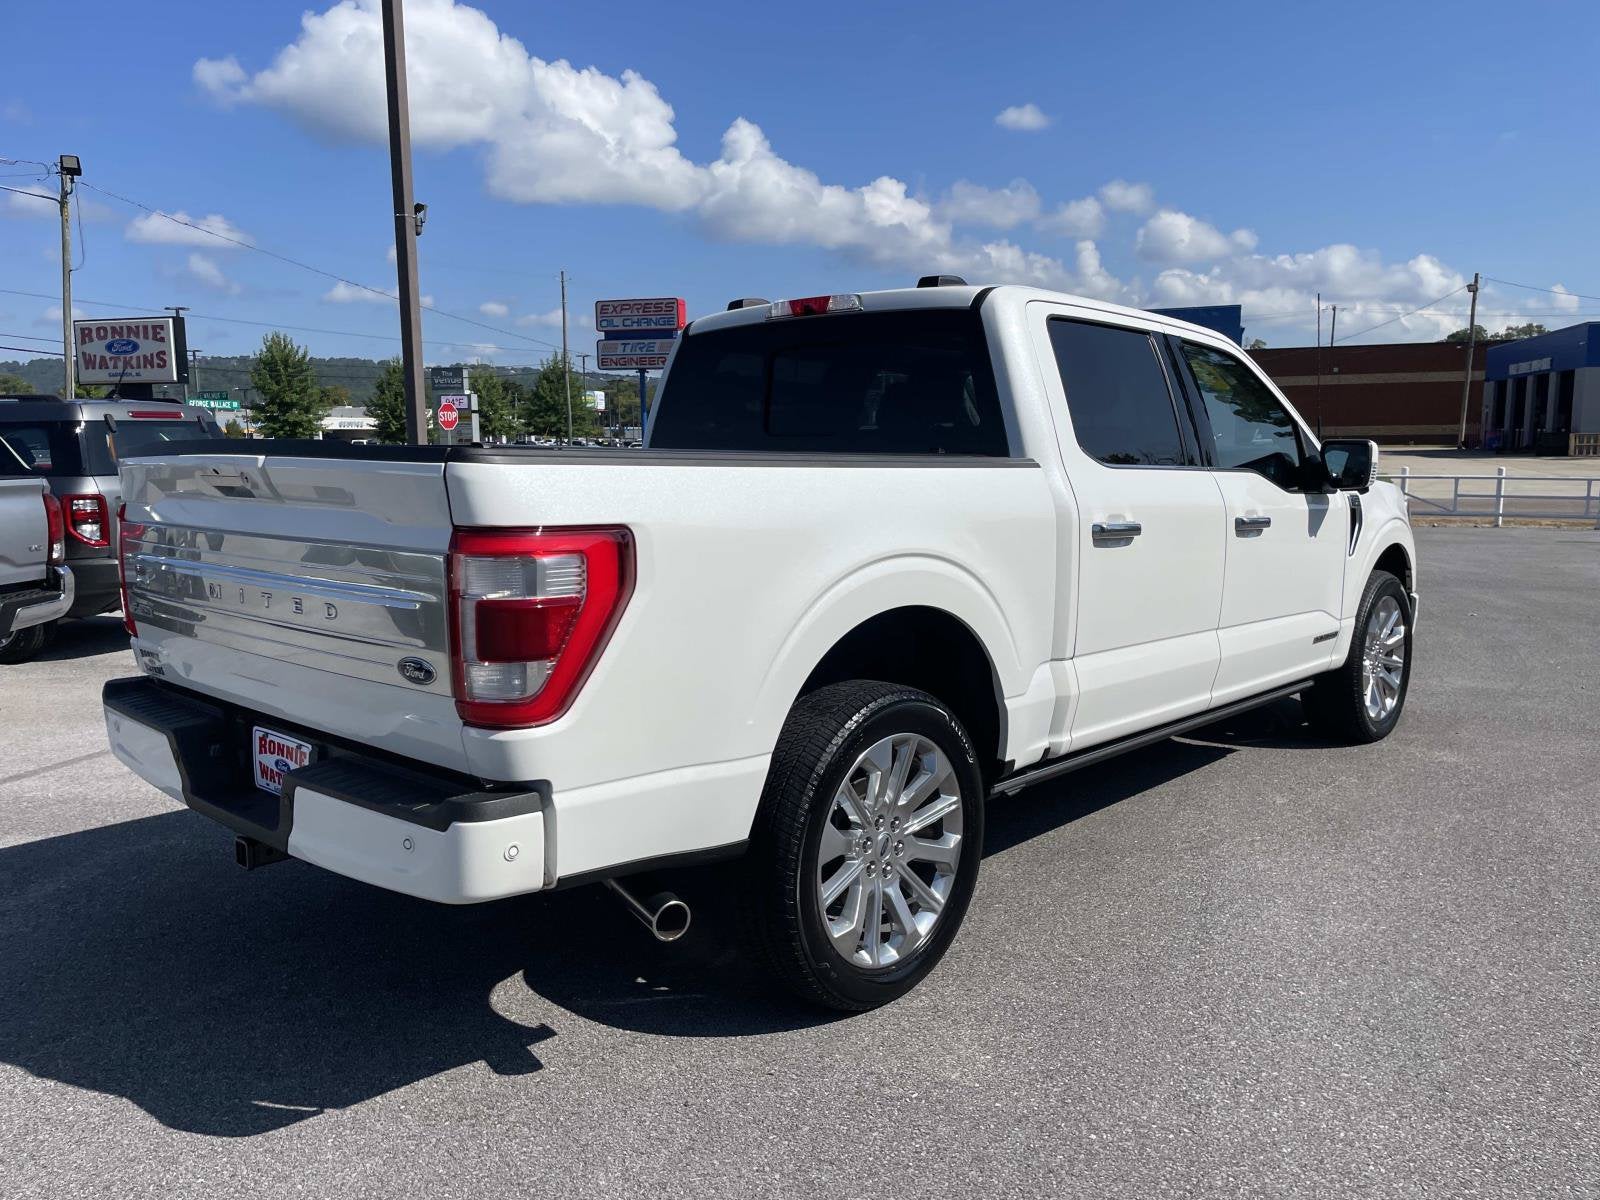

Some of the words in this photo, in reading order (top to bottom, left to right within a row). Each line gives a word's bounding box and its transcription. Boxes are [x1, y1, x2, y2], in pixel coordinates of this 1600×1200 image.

[600, 302, 675, 314] EXPRESS
[600, 318, 619, 328] OIL
[622, 317, 676, 327] CHANGE
[80, 324, 166, 346] RONNIE
[620, 342, 656, 353] TIRE
[82, 350, 167, 370] WATKINS
[439, 411, 457, 422] STOP
[258, 736, 307, 768] RONNIE
